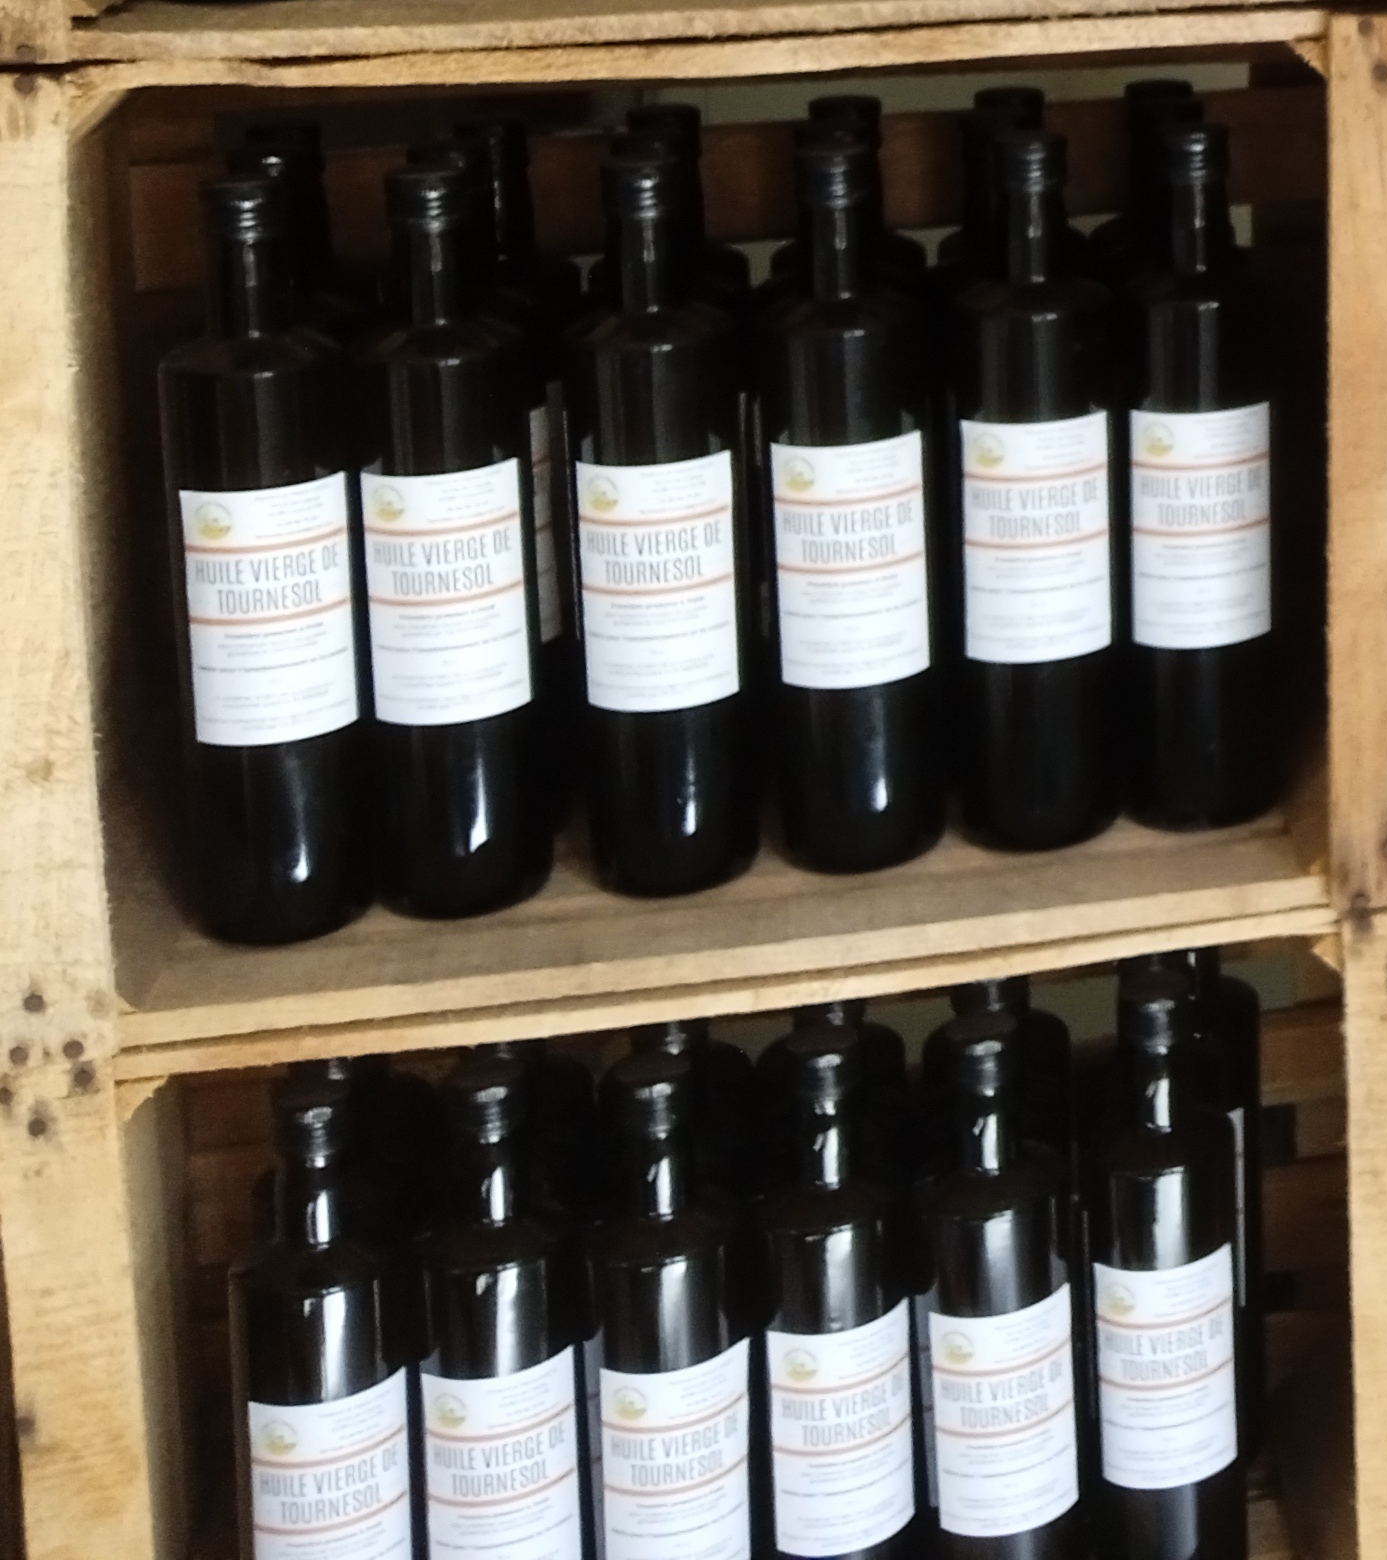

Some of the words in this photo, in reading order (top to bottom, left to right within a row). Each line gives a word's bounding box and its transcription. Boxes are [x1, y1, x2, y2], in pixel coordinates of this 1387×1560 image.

[971, 485, 1013, 509] HUILE
[1018, 482, 1079, 509] VIERGE
[1083, 478, 1098, 503] DE
[1140, 473, 1181, 497] HUILE
[1185, 470, 1244, 497] VIERGE
[1248, 467, 1265, 490] DE
[783, 510, 825, 535] HUILE
[830, 504, 892, 534] VIERGE
[896, 499, 914, 524] DE
[988, 511, 1082, 538] TOURNESOL
[1156, 498, 1247, 525] TOURNESOL
[373, 541, 417, 567] HUILE
[422, 534, 488, 565] VIERGE
[492, 529, 512, 554] DE
[586, 531, 630, 556] HUILE
[634, 523, 698, 555] VIERGE
[702, 520, 722, 545] DE
[800, 534, 897, 563] TOURNESOL
[195, 556, 244, 585] HUILE
[250, 548, 317, 581] VIERGE
[321, 543, 340, 570] DE
[391, 567, 494, 596] TOURNESOL
[603, 554, 705, 584] TOURNESOL
[216, 582, 323, 612] TOURNESOL
[1103, 1331, 1145, 1354] HUILE
[1149, 1324, 1206, 1355] VIERGE
[941, 1378, 983, 1402] HUILE
[988, 1367, 1046, 1403] VIERGE
[1048, 1361, 1064, 1385] DE
[1121, 1352, 1209, 1379] TOURNESOL
[781, 1395, 827, 1421] HUILE
[831, 1380, 889, 1418] VIERGE
[892, 1370, 906, 1398] DE
[960, 1394, 1049, 1429] TOURNESOL
[610, 1436, 657, 1462] HUILE
[662, 1423, 722, 1461] VIERGE
[724, 1415, 739, 1438] DE
[801, 1407, 893, 1447] TOURNESOL
[432, 1442, 477, 1468] HUILE
[482, 1433, 545, 1467] VIERGE
[549, 1424, 566, 1450] DE
[259, 1469, 308, 1497] HUILE
[312, 1454, 379, 1494] VIERGE
[381, 1448, 399, 1473] DE
[451, 1462, 549, 1497] TOURNESOL
[630, 1450, 725, 1487] TOURNESOL
[280, 1482, 384, 1524] TOURNESOL
